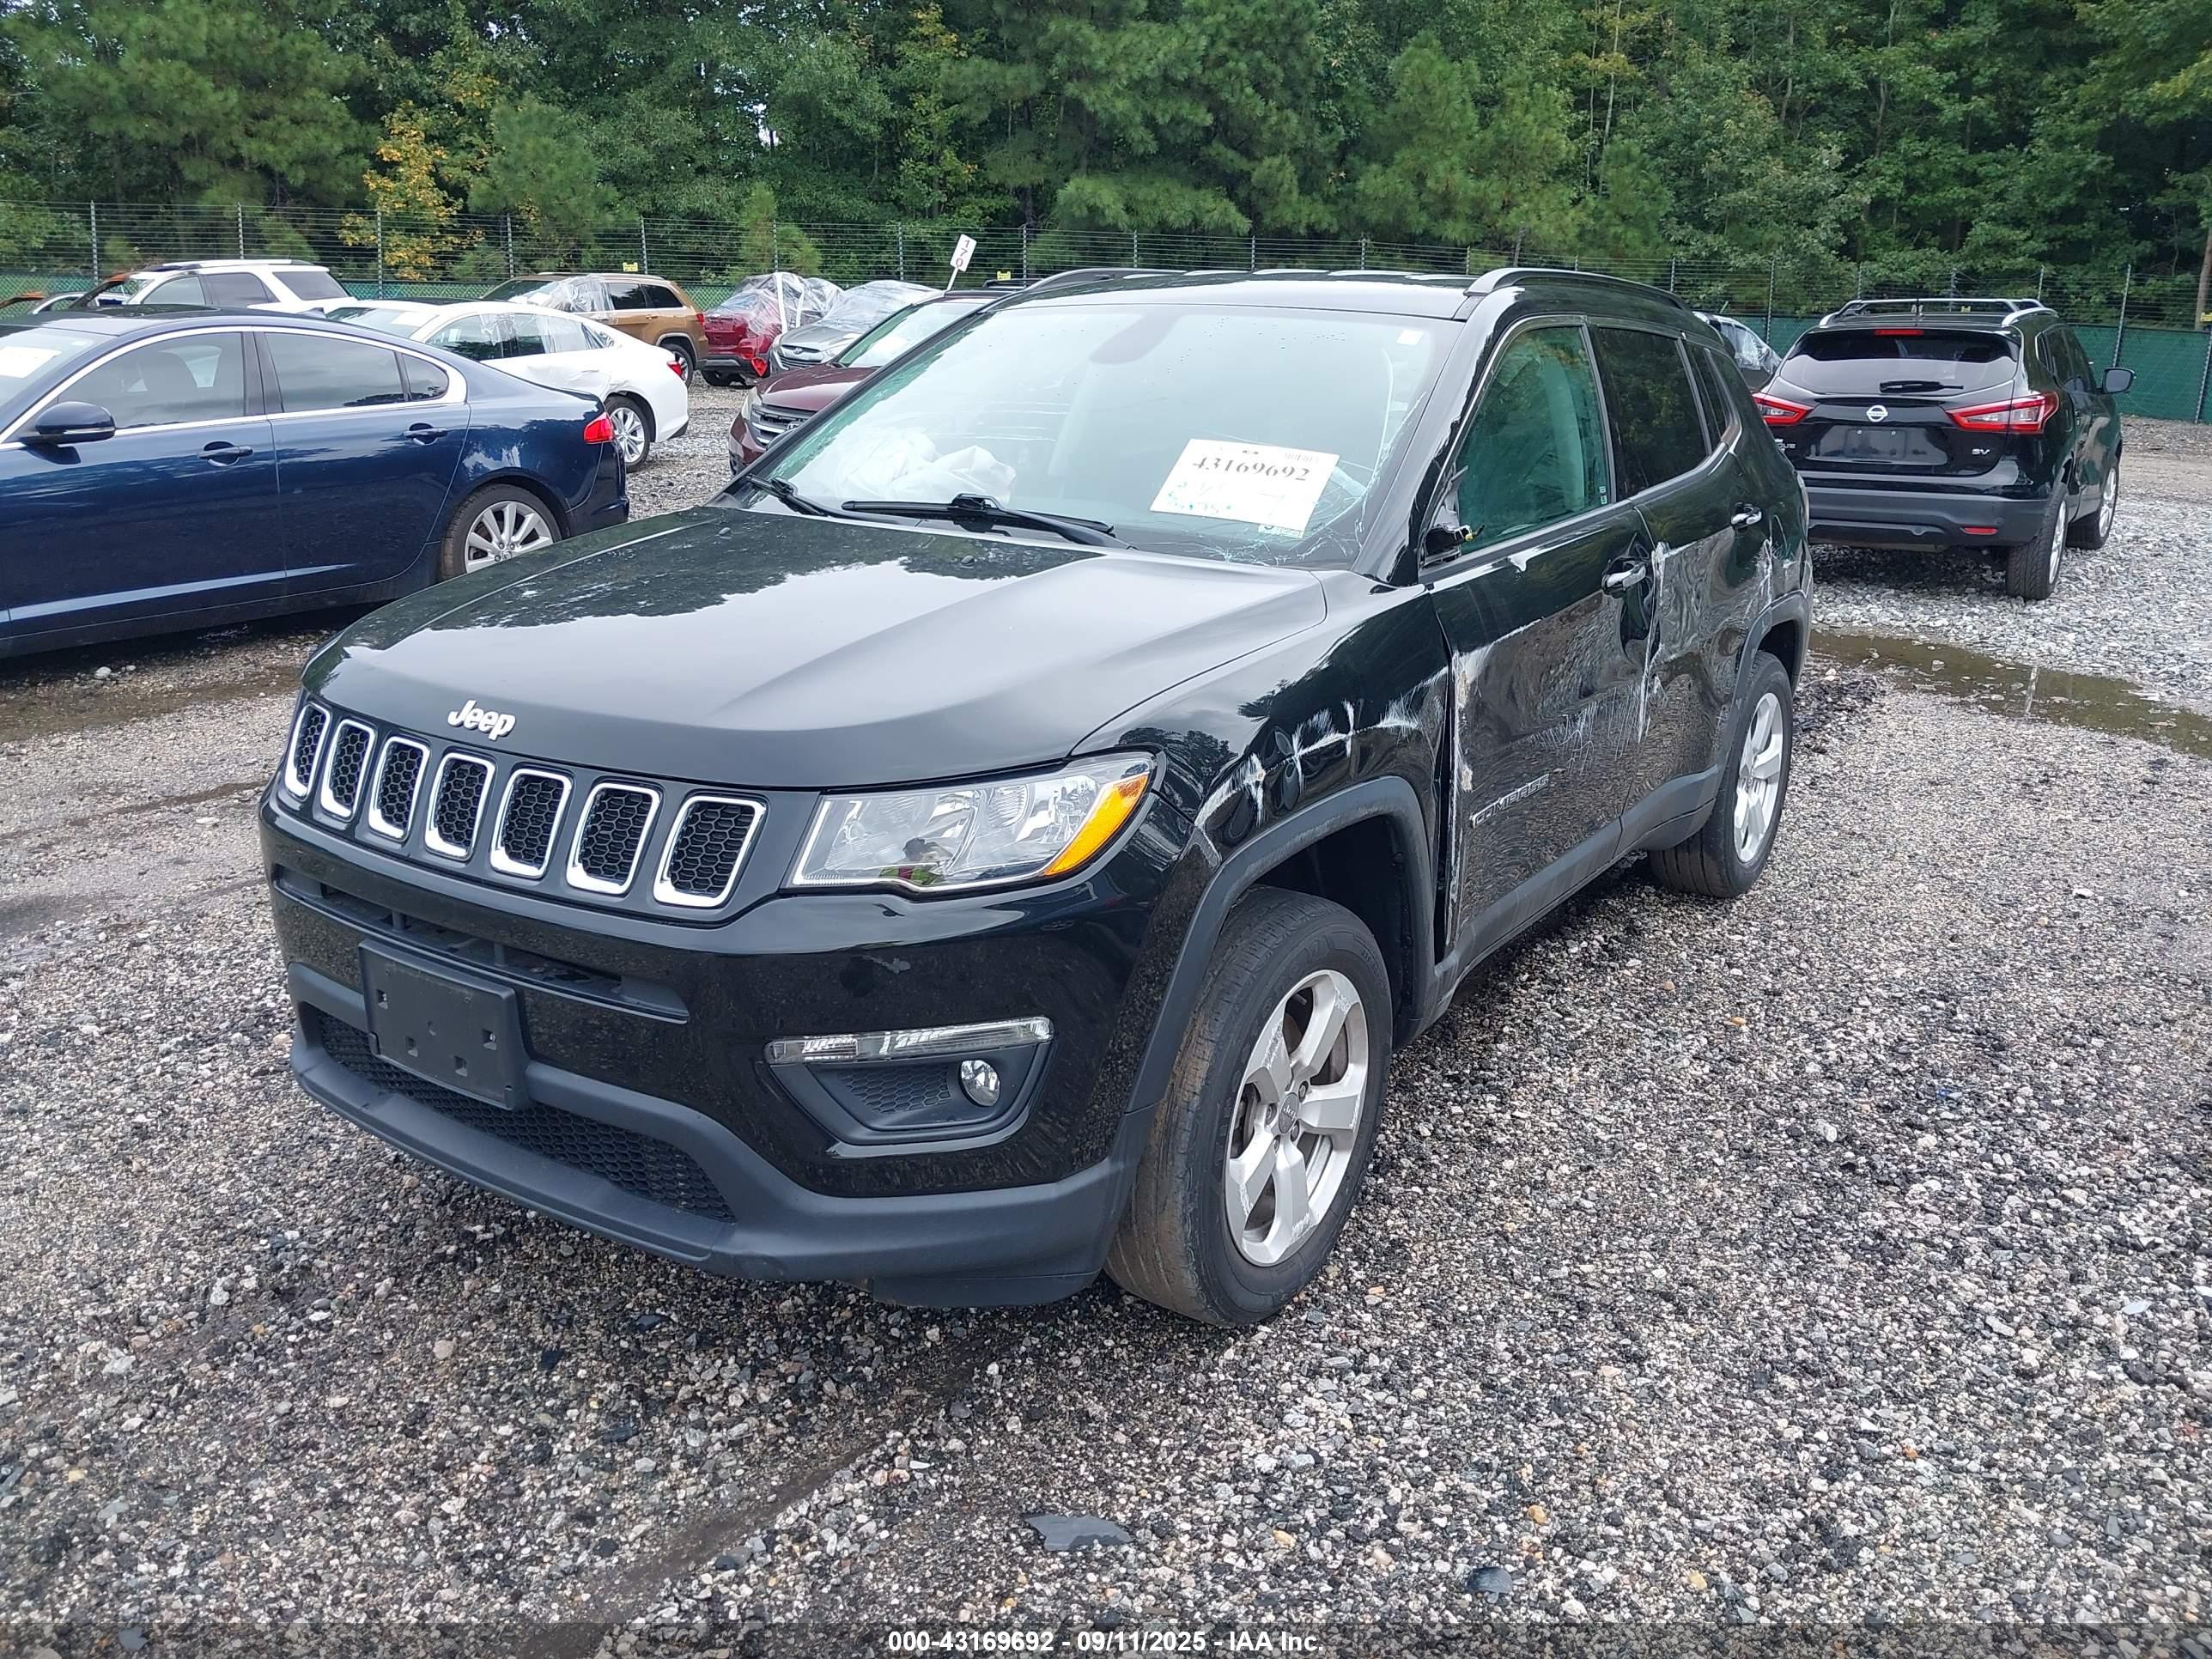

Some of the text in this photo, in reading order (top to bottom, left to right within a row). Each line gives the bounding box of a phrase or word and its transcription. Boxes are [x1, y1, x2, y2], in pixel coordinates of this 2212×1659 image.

[956, 240, 969, 267] 170
[1192, 456, 1310, 482] 43169692
[447, 699, 517, 741] Jeep
[1469, 774, 1550, 829] COMPASS
